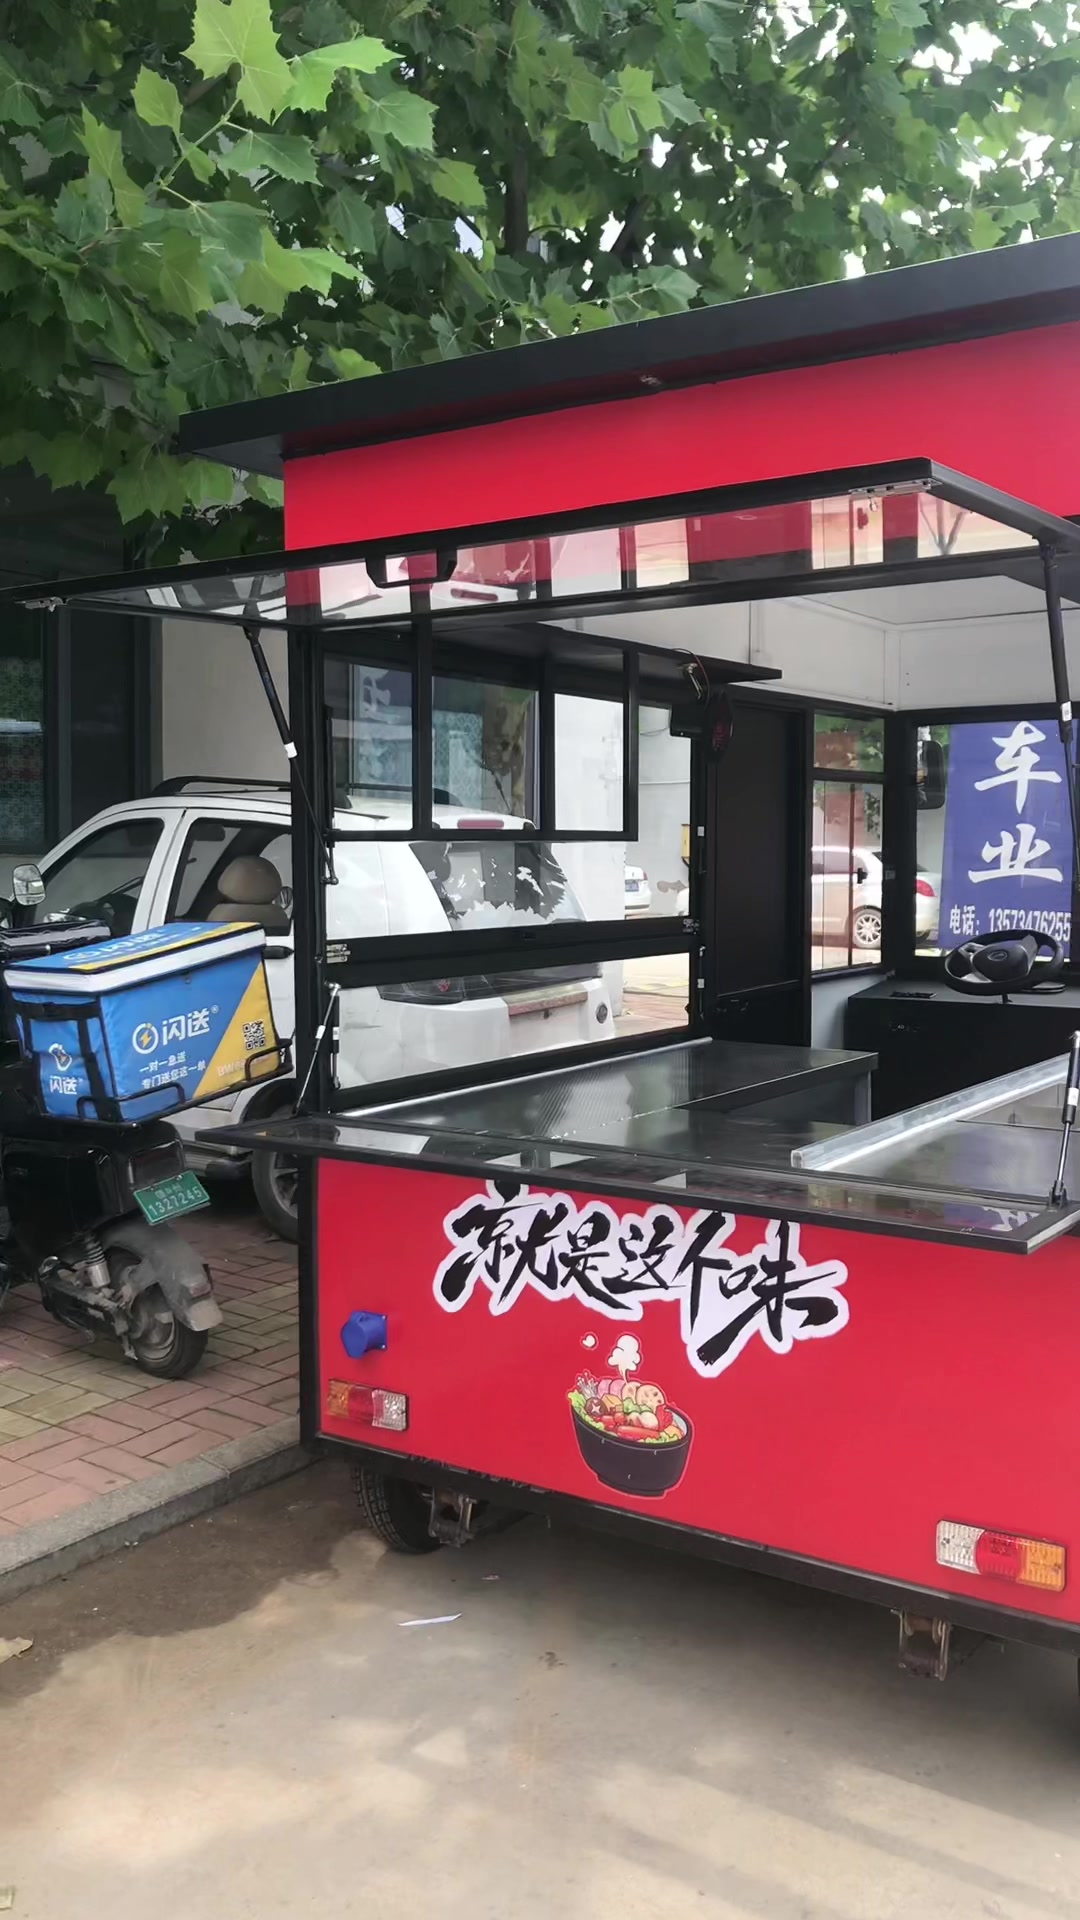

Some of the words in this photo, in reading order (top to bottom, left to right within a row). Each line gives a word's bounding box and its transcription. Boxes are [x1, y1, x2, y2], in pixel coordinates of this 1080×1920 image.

[967, 721, 1063, 883] 车业
[162, 1007, 210, 1046] 闪送
[49, 1074, 78, 1095] 闪送
[148, 1185, 203, 1216] 1327245
[440, 1180, 840, 1367] 就是这个味
